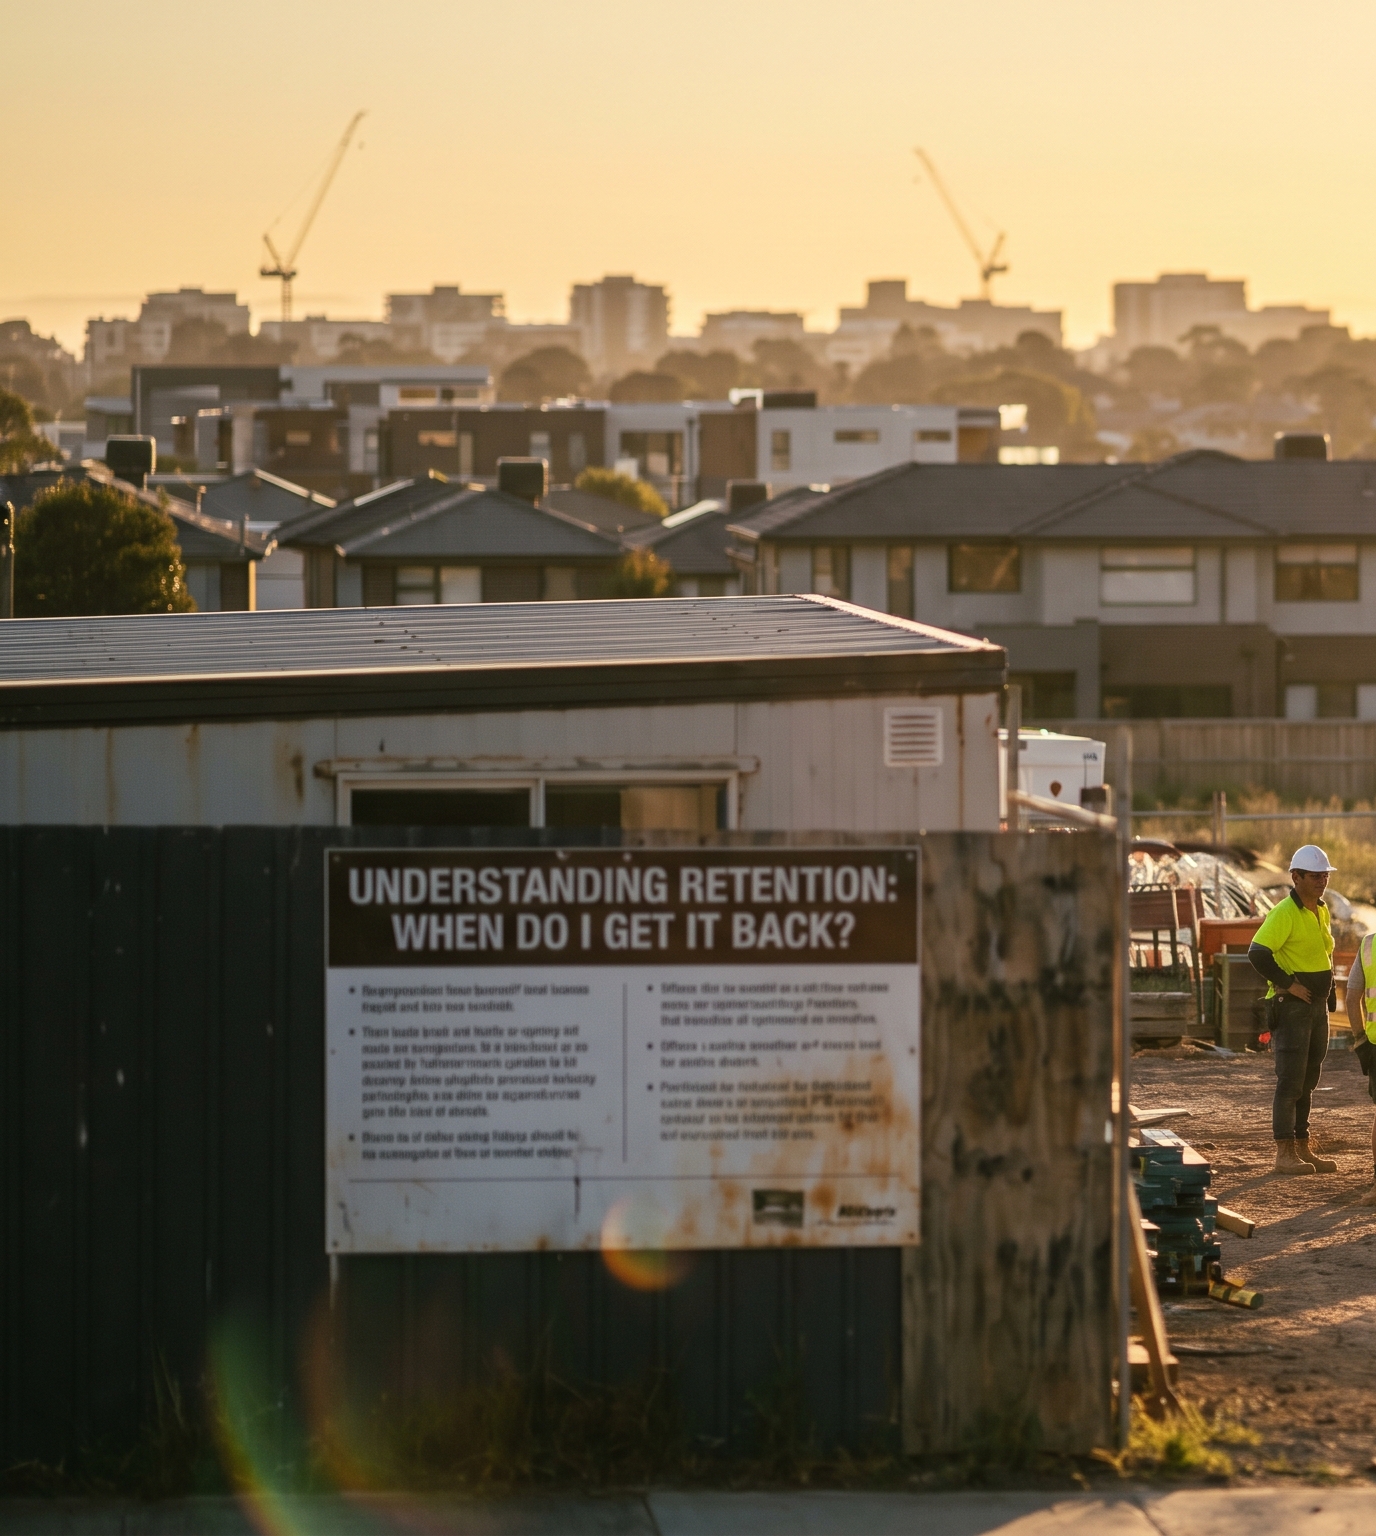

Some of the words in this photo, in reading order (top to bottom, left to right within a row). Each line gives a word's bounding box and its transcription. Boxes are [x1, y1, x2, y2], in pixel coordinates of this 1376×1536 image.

[348, 866, 668, 905] UNDERSTANDING
[679, 865, 898, 904] RETENTION:
[391, 913, 504, 951] WHEN
[517, 913, 569, 950] DO
[580, 913, 592, 950] I
[603, 912, 676, 950] GET
[686, 912, 722, 950] IT
[732, 911, 856, 950] BACK?
